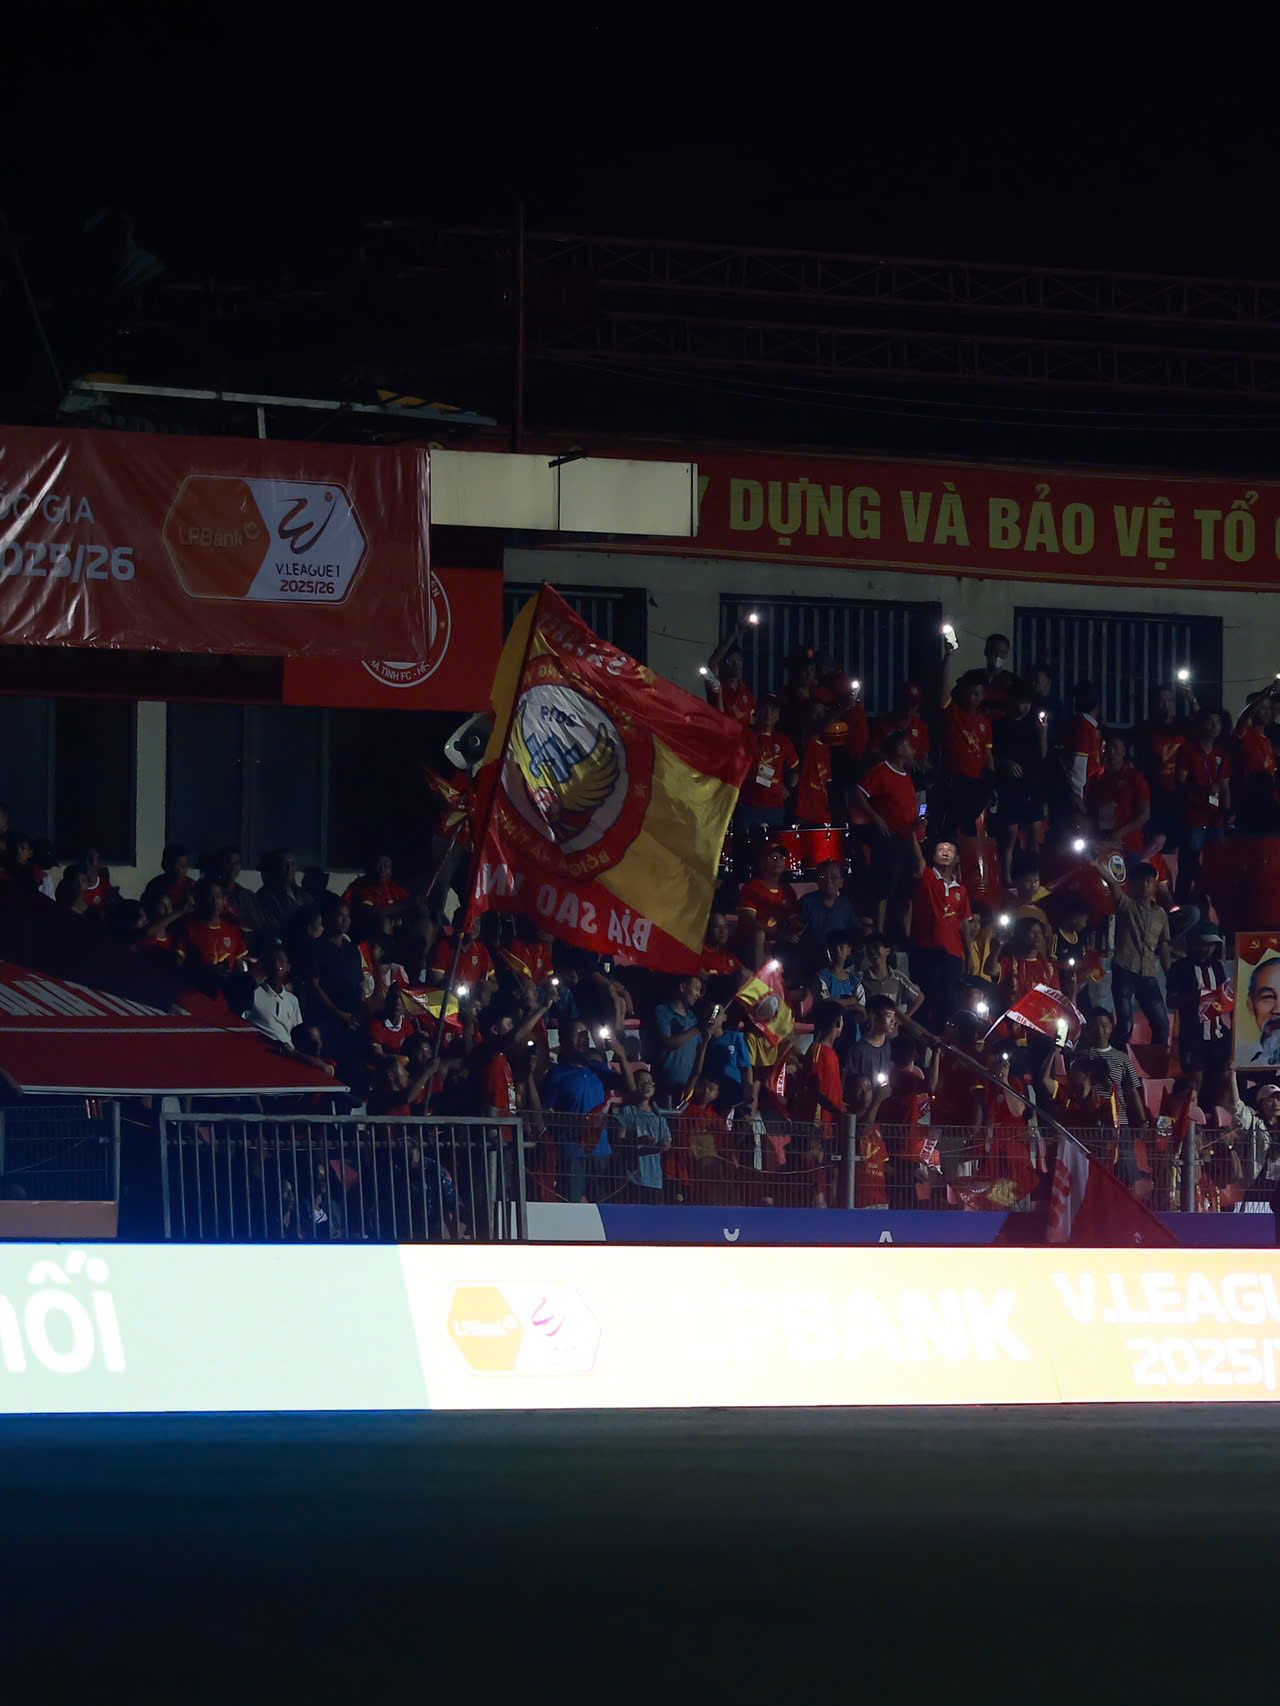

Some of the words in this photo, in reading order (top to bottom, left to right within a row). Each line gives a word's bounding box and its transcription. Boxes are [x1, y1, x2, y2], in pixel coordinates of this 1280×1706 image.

[42, 494, 95, 525] GIA
[729, 475, 881, 546] DỰNG
[900, 481, 970, 548] VÀ
[988, 483, 1096, 556] BẢO
[1113, 496, 1176, 571] VỆ
[1193, 490, 1259, 563] TỔ
[178, 523, 243, 549] LPBank
[276, 563, 334, 577] V.LEAGUE
[279, 579, 336, 595] 2025/26
[676, 1289, 1033, 1362] LPBANK
